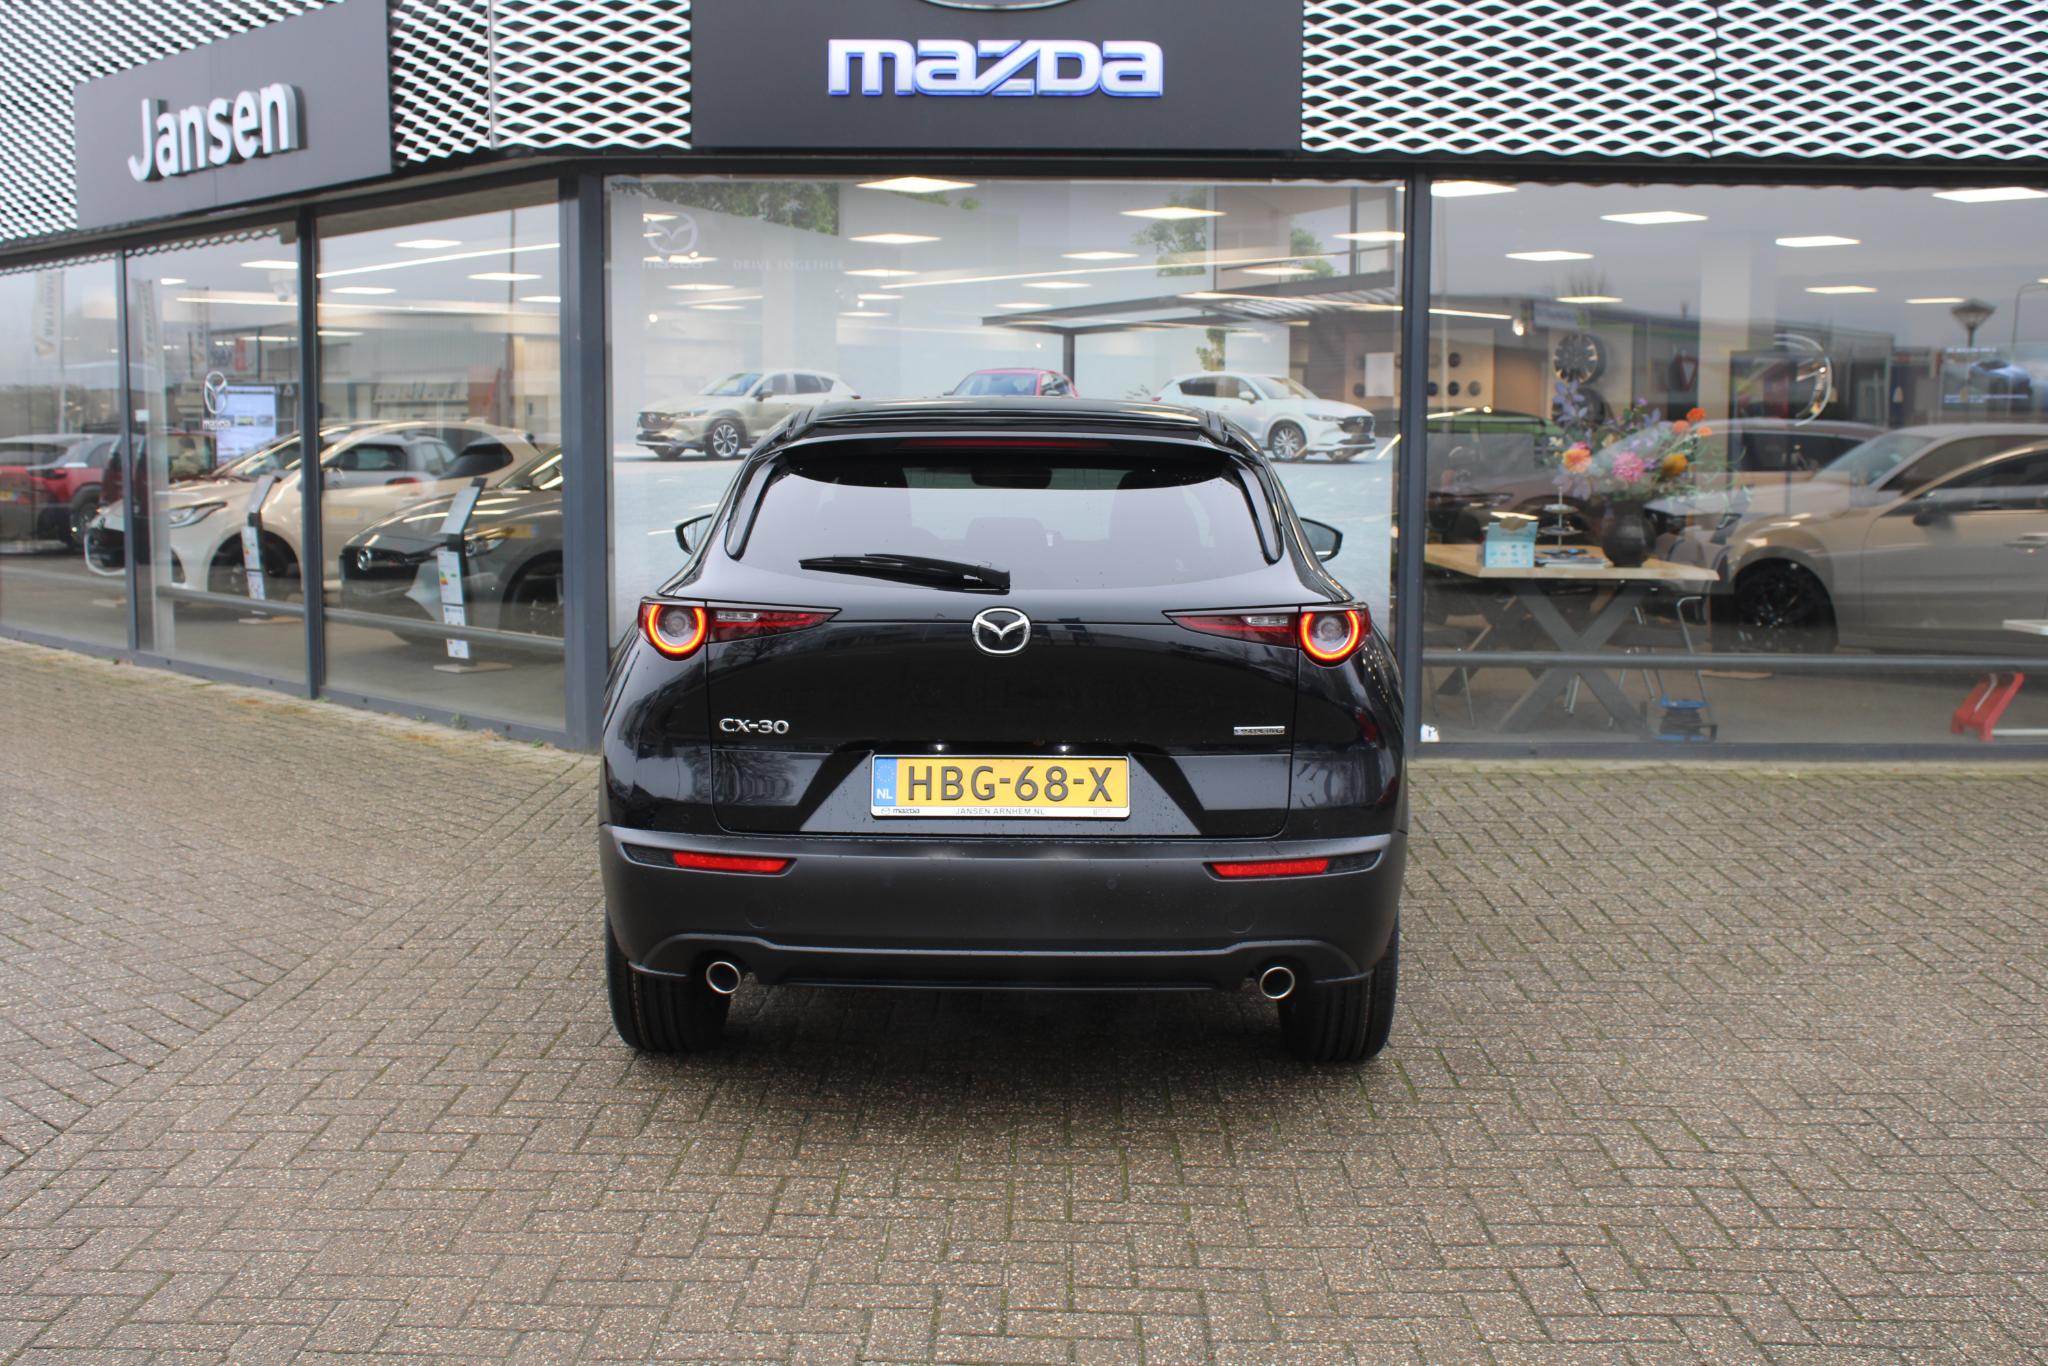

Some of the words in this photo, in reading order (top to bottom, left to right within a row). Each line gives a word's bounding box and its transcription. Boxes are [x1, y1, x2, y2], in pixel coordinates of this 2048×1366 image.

[827, 38, 1164, 97] mazda
[127, 82, 299, 182] Jansen
[733, 259, 769, 272] DRIVE
[776, 259, 845, 272] TOGETHER
[718, 718, 790, 734] CX-30
[908, 765, 1112, 802] HBG-68-X
[876, 788, 893, 799] NL
[955, 807, 990, 815] JANSEN
